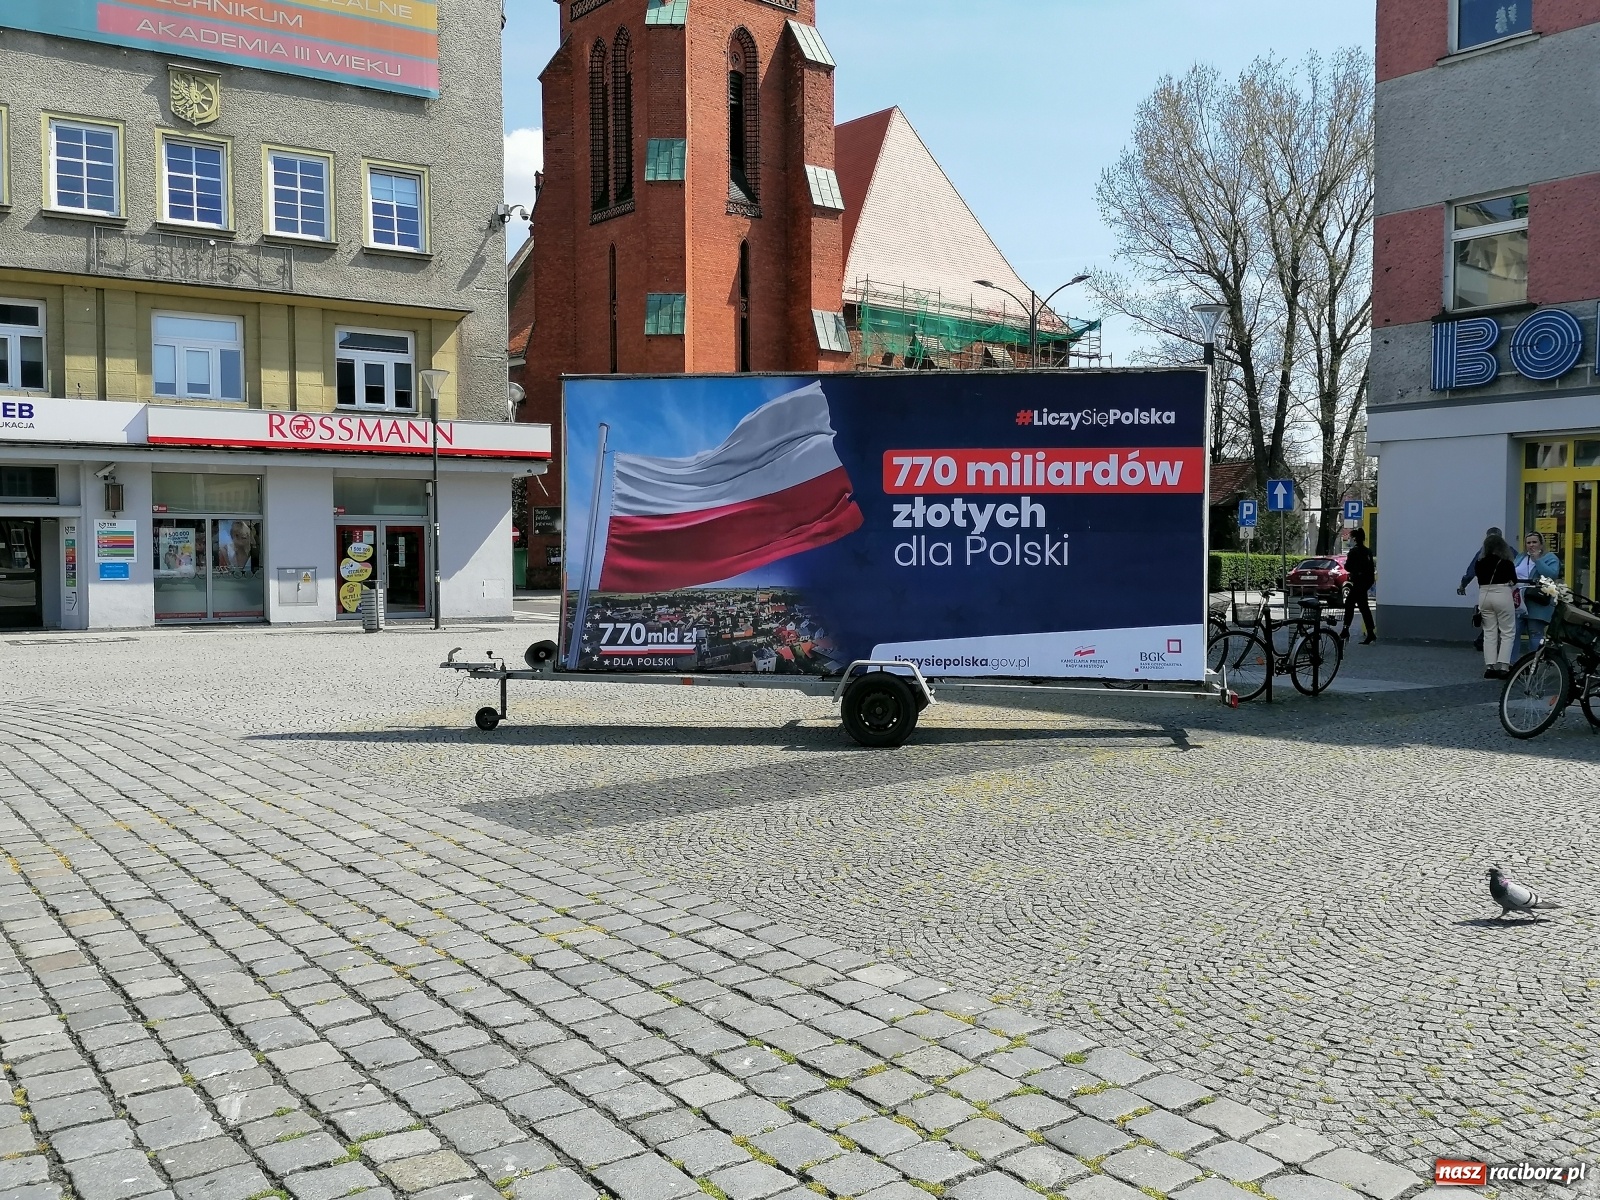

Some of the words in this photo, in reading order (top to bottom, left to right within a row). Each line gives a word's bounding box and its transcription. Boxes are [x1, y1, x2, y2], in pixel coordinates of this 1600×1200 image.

[154, 0, 303, 28] HNIKUM
[320, 0, 412, 19] ALNE
[136, 18, 289, 58] AKADEMIA
[294, 45, 310, 61] III
[316, 49, 402, 77] WIEKU
[1430, 308, 1600, 392] BO
[267, 413, 453, 446] ROSSMANN
[1015, 407, 1176, 431] #LiczySięPolska
[892, 456, 958, 487] 770
[966, 449, 1184, 487] miliardów
[892, 496, 1046, 534] złotych
[1242, 502, 1254, 519] P
[1347, 502, 1359, 517] P
[894, 534, 952, 567] dla
[966, 533, 1069, 566] Polski
[598, 622, 646, 645] 770
[647, 627, 679, 643] mld
[683, 627, 698, 643] zł
[613, 657, 634, 666] DLA
[637, 657, 674, 666] POLSKI
[1139, 651, 1167, 662] BGK
